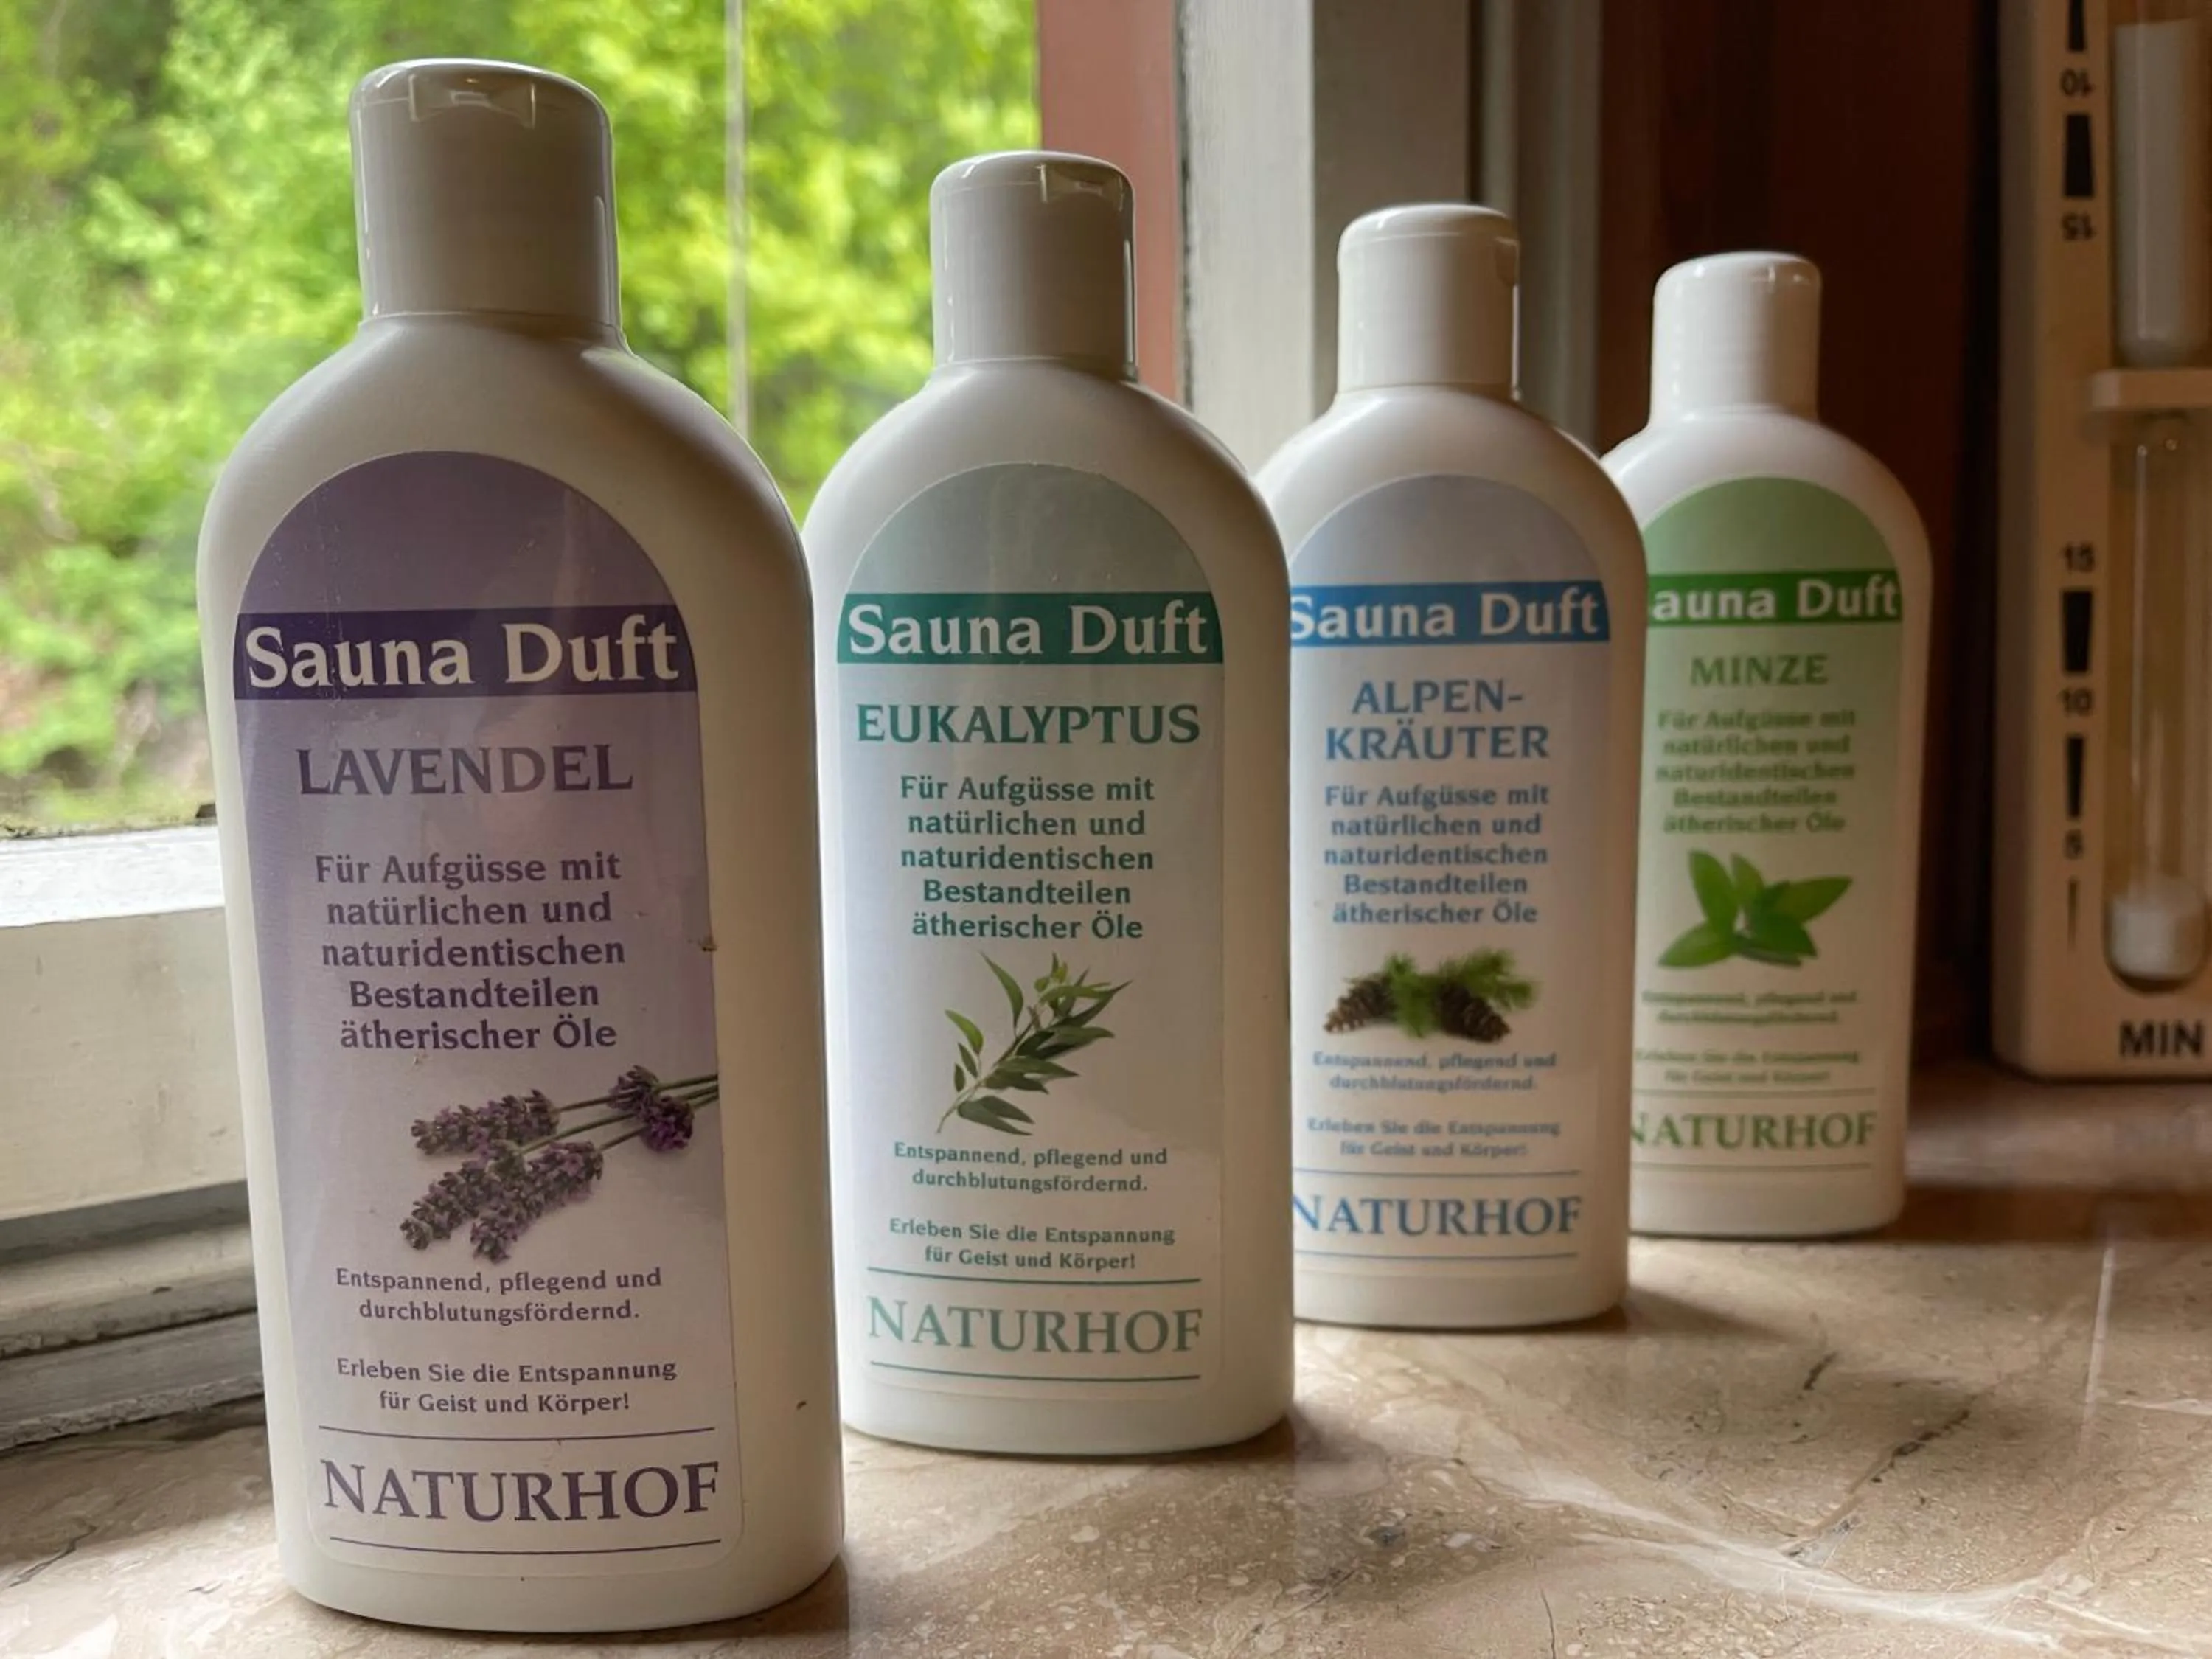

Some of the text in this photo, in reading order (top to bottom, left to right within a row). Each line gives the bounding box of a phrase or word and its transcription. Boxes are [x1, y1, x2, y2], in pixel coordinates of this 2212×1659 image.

[2063, 545, 2095, 573] 15
[1652, 575, 1898, 620] auna Duft
[849, 600, 1207, 655] Sauna Duft
[1291, 588, 1599, 640] Sauna Duft
[246, 615, 678, 689] Sauna Duft
[1690, 655, 1829, 686] MINZE
[1352, 679, 1523, 715] ALPEN-
[2059, 689, 2092, 714] 10
[858, 703, 1200, 744] EUKALYPTUS
[1326, 719, 1550, 760] KRÄUTER
[296, 744, 633, 796] LAVENDEL
[900, 776, 1155, 806] Für Aufgüsse mit
[1324, 784, 1549, 810] Für Aufgüsse mit
[908, 810, 1145, 835] natürlichen und
[1331, 814, 1541, 836] natürlichen und
[901, 846, 1154, 870] naturidentischen
[1324, 843, 1548, 865] naturidentischen
[316, 851, 621, 890] Für Aufgüsse mit
[1343, 873, 1527, 894] Bestandteilen
[924, 880, 1130, 904] Bestandteilen
[327, 892, 611, 925] natürlichen und
[1333, 898, 1538, 924] ätherischer Öle
[913, 911, 1143, 939] ätherischer Öle
[322, 936, 625, 967] naturidentischen
[349, 978, 599, 1007] Bestandteilen
[341, 1015, 616, 1050] ätherischer Öle
[2118, 1020, 2204, 1057] MIN
[894, 1141, 1167, 1168] Entspannend, pflegend und
[912, 1169, 1148, 1194] durchblutungsfördernd.
[1294, 1194, 1582, 1237] NATURHOF
[891, 1219, 1175, 1246] Erleben Sie die Entspannung
[925, 1245, 1135, 1273] für Geist und Körper!
[335, 1267, 661, 1295] Entspannend, pflegend und
[359, 1299, 640, 1326] durchblutungsfördernd.
[868, 1296, 1202, 1354] NATURHOF
[336, 1358, 677, 1385] Erleben Sie die Entspannung
[380, 1391, 629, 1415] für Geist und Körper!
[321, 1459, 719, 1522] NATURHOF
